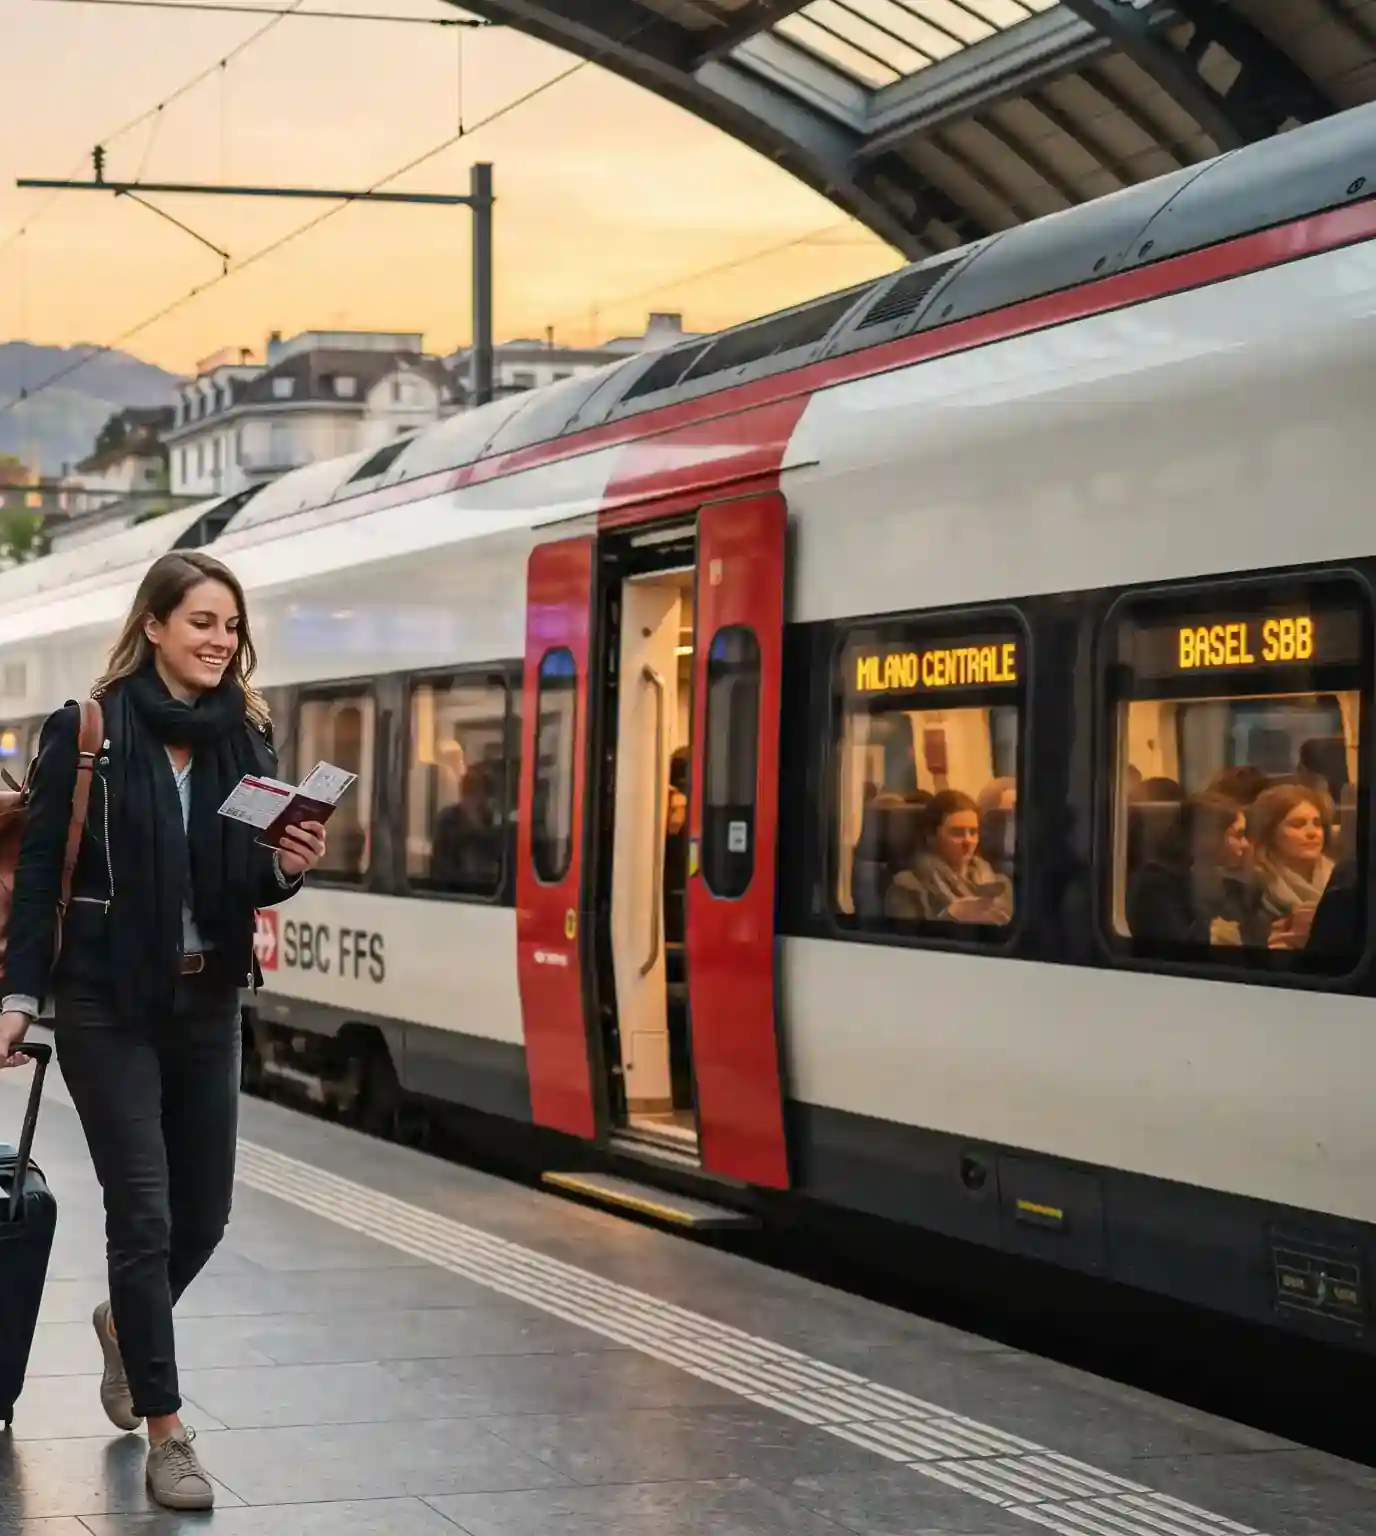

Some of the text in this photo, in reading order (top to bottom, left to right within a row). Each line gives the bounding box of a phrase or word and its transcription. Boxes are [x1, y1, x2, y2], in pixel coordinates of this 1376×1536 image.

[857, 643, 1016, 691] MILANO CENTRALE
[1179, 617, 1313, 668] BASEL SBB
[284, 919, 386, 984] SBC FFS
